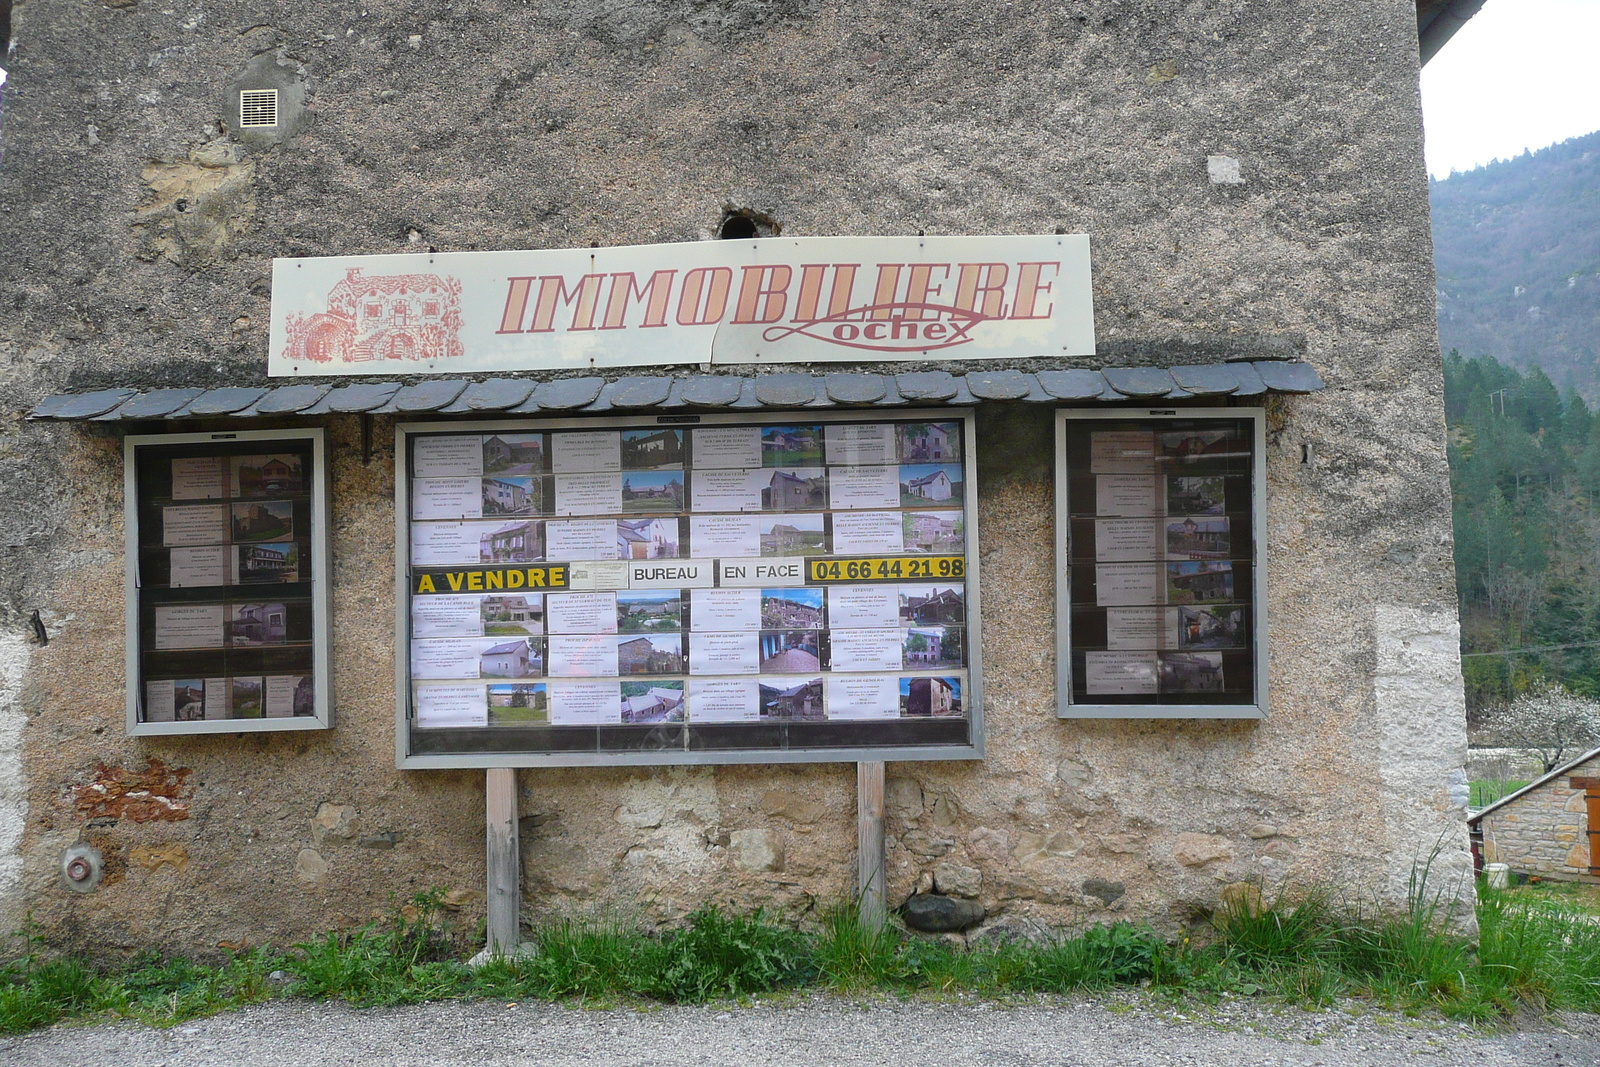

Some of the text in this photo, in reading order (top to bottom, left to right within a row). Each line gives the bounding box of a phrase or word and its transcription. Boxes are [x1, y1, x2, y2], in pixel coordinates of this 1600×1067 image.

[495, 261, 1061, 335] IMMOBILIERE
[634, 567, 699, 581] BUREAU
[724, 564, 800, 579] EN FACE
[816, 559, 964, 579] 04 66 44 21 98
[417, 574, 437, 594] A
[446, 567, 566, 592] VENDRE
